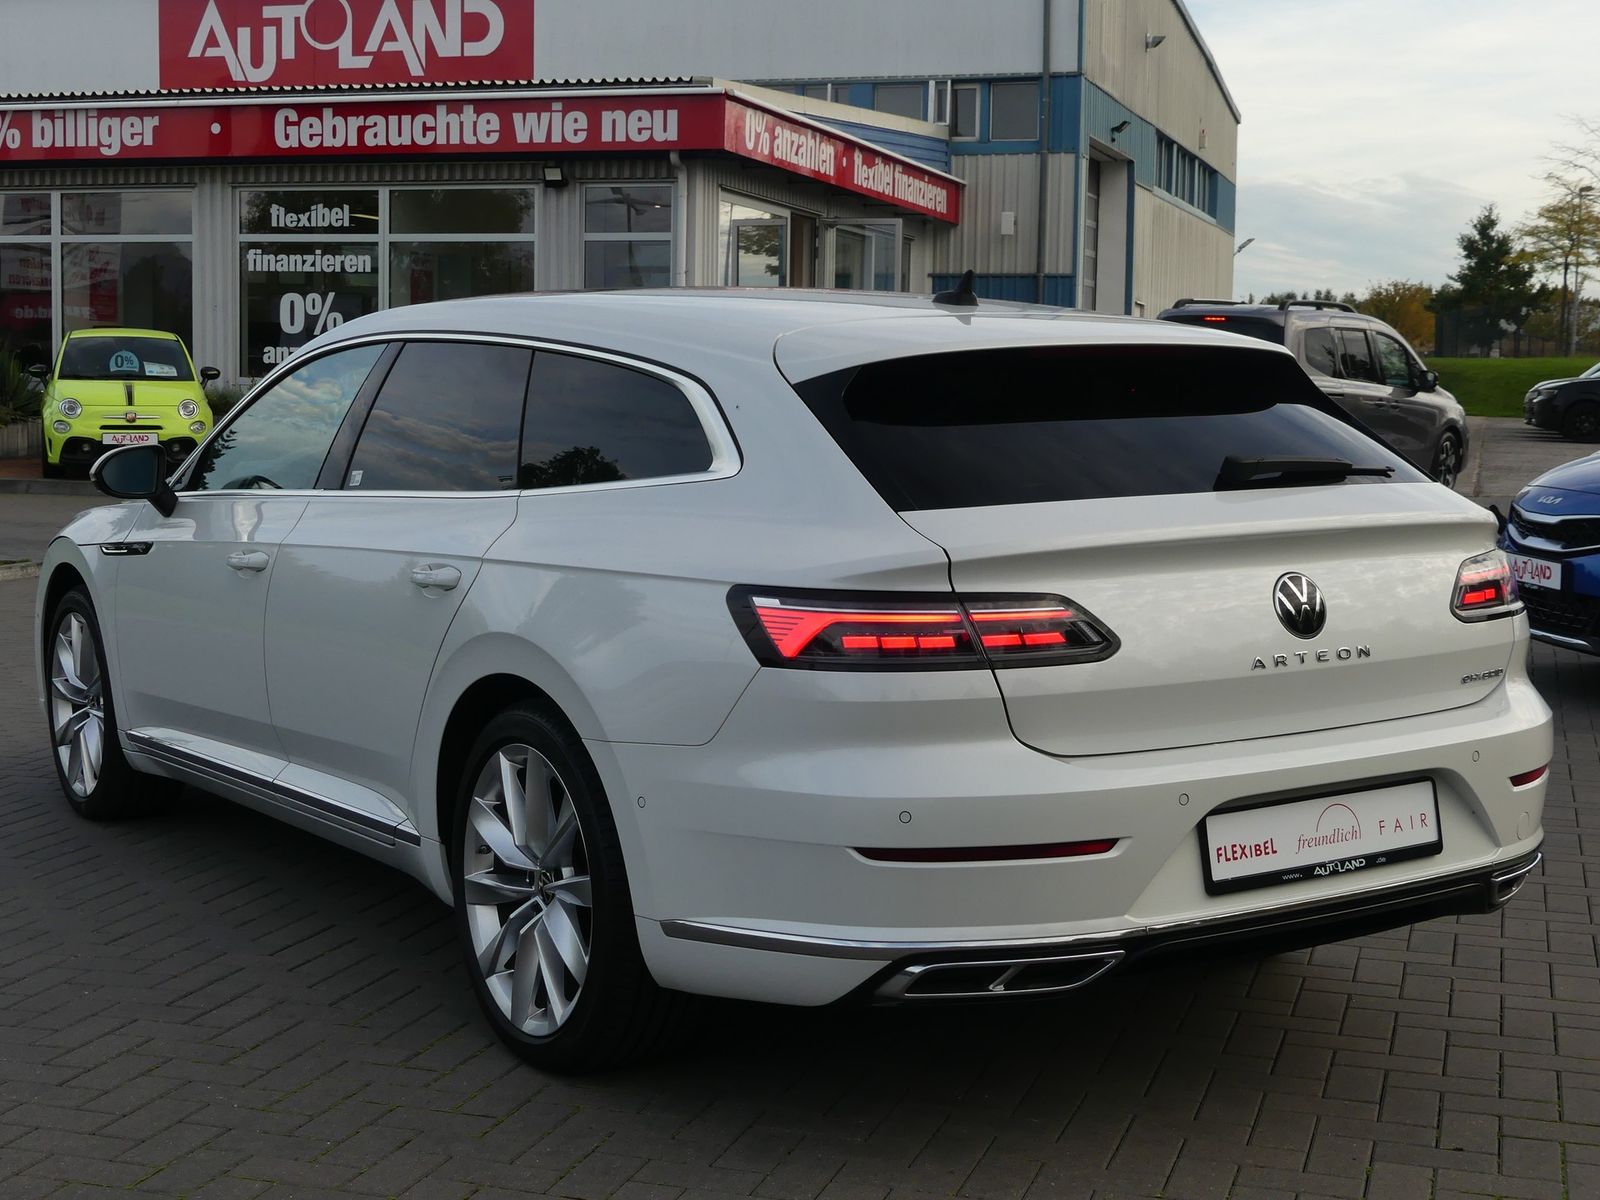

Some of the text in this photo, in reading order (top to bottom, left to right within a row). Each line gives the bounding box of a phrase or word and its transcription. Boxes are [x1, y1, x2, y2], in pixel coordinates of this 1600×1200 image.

[32, 110, 160, 156] billiger
[274, 104, 500, 148] Gebrauchte
[513, 102, 588, 144] wie
[601, 108, 679, 143] neu
[745, 110, 948, 214] 0% anzahlen flexibel finanzieren
[270, 203, 350, 228] flexibel
[247, 249, 372, 273] finanzieren
[279, 292, 344, 336] 0%
[1251, 645, 1371, 671] ARTEON
[1216, 812, 1429, 864] FLEXIBEL freundlich FAIR
